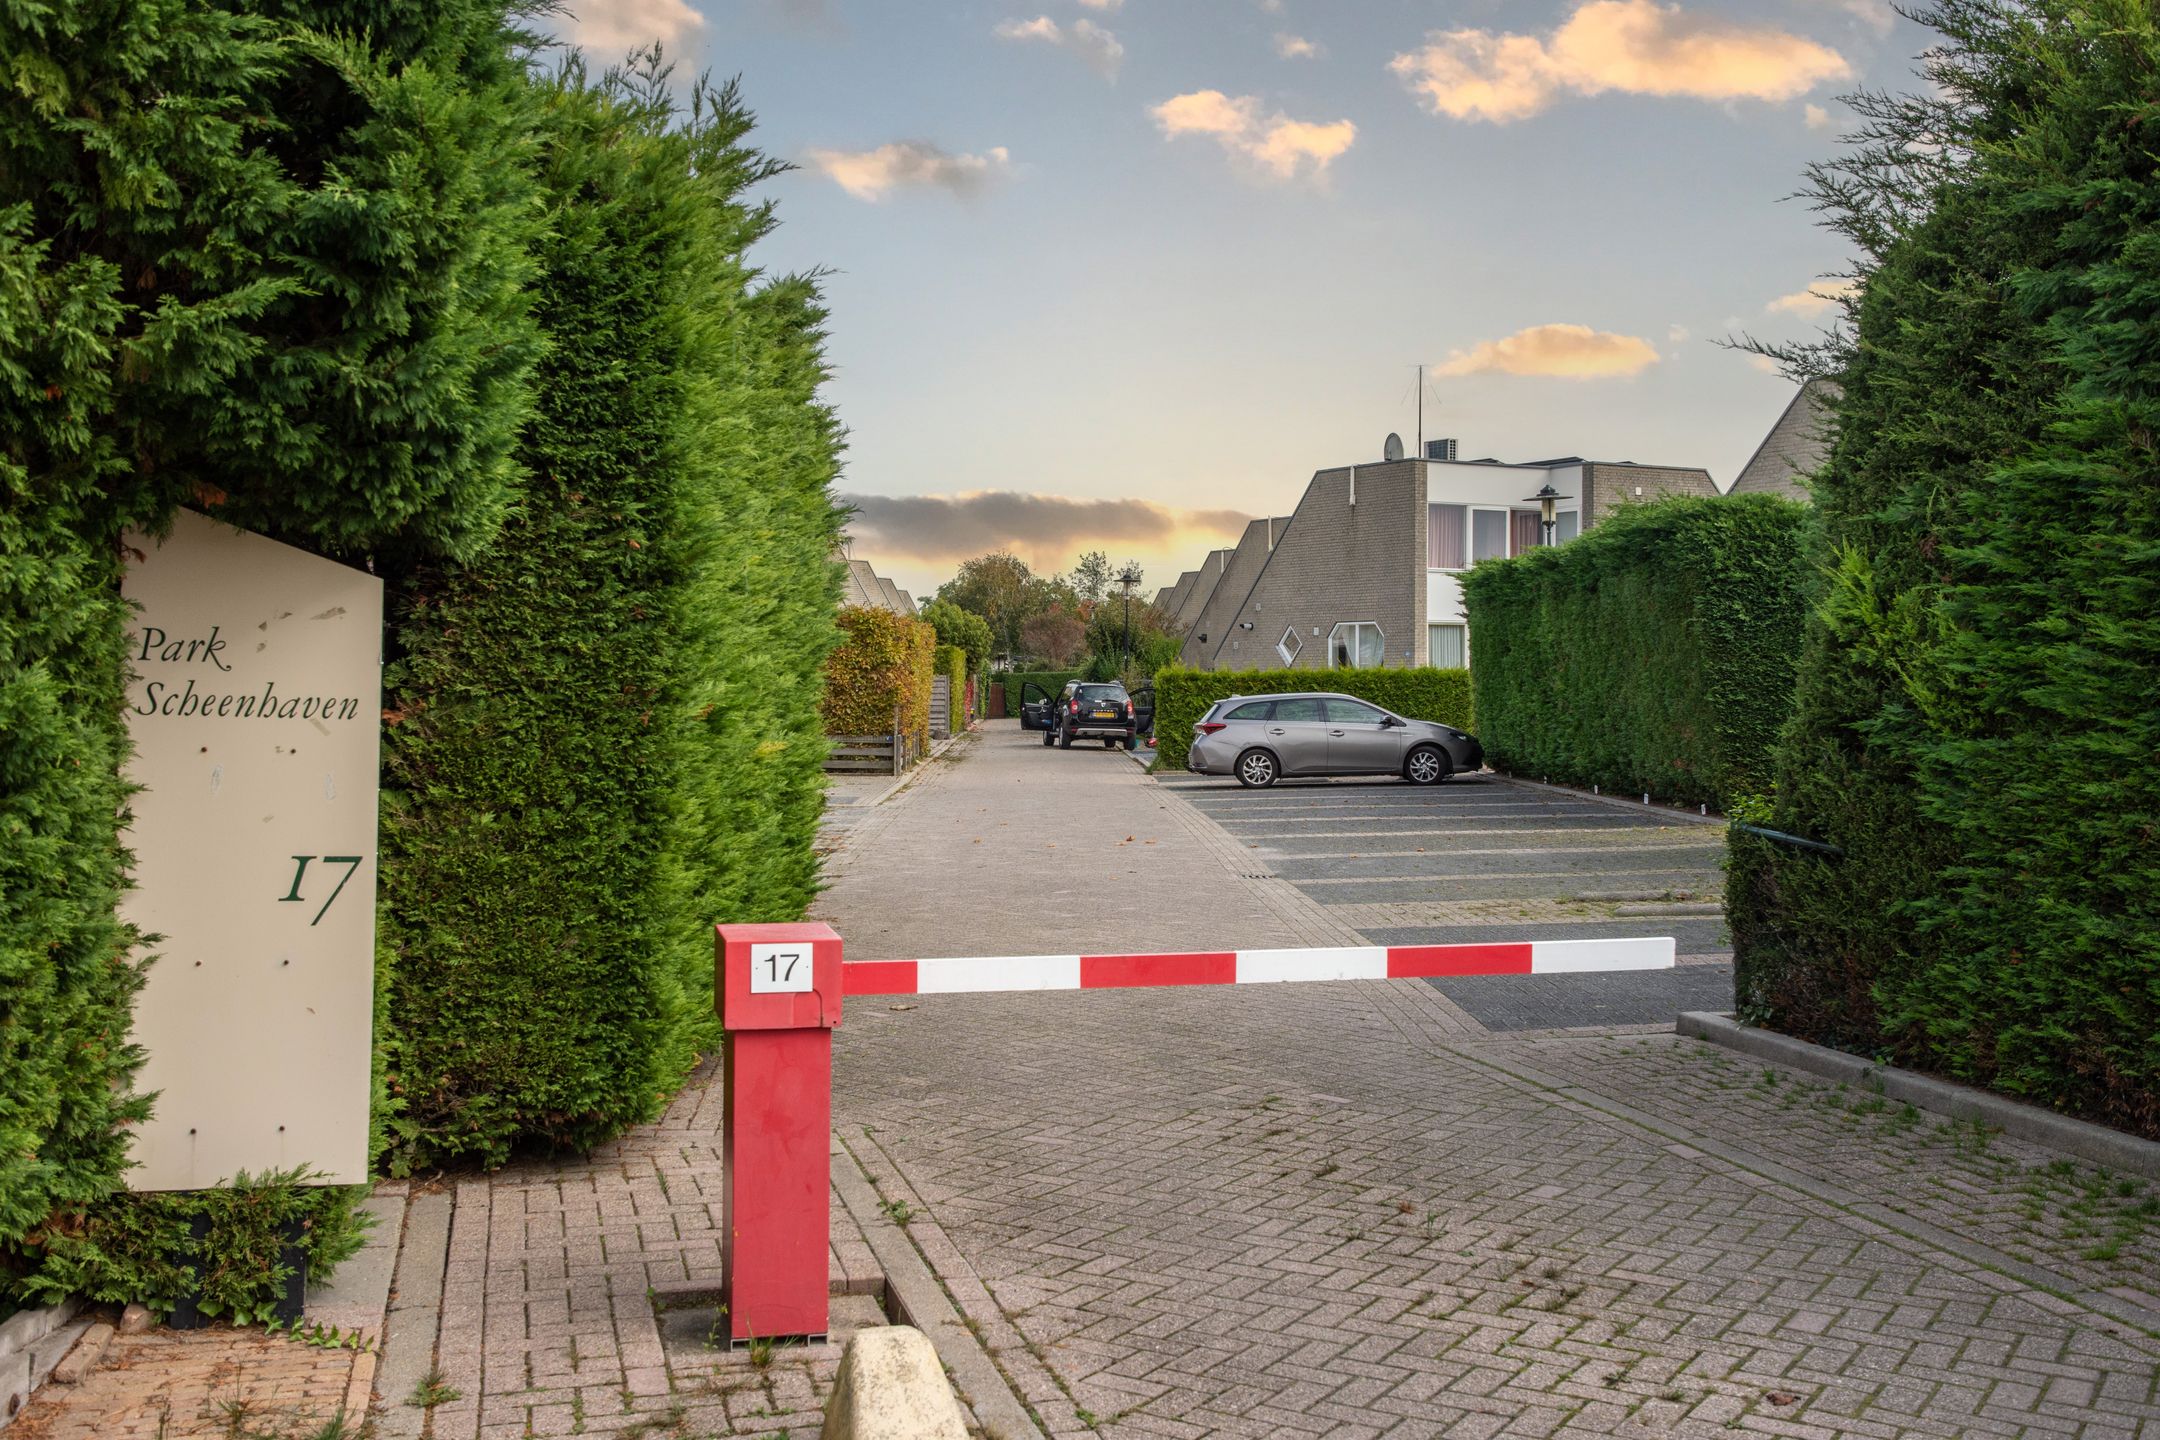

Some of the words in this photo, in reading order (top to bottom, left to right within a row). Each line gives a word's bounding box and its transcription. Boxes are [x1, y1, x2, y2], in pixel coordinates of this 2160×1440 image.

[137, 626, 232, 672] Park
[137, 679, 359, 720] Scheenhaven
[278, 855, 363, 926] 17
[764, 953, 800, 982] 17
